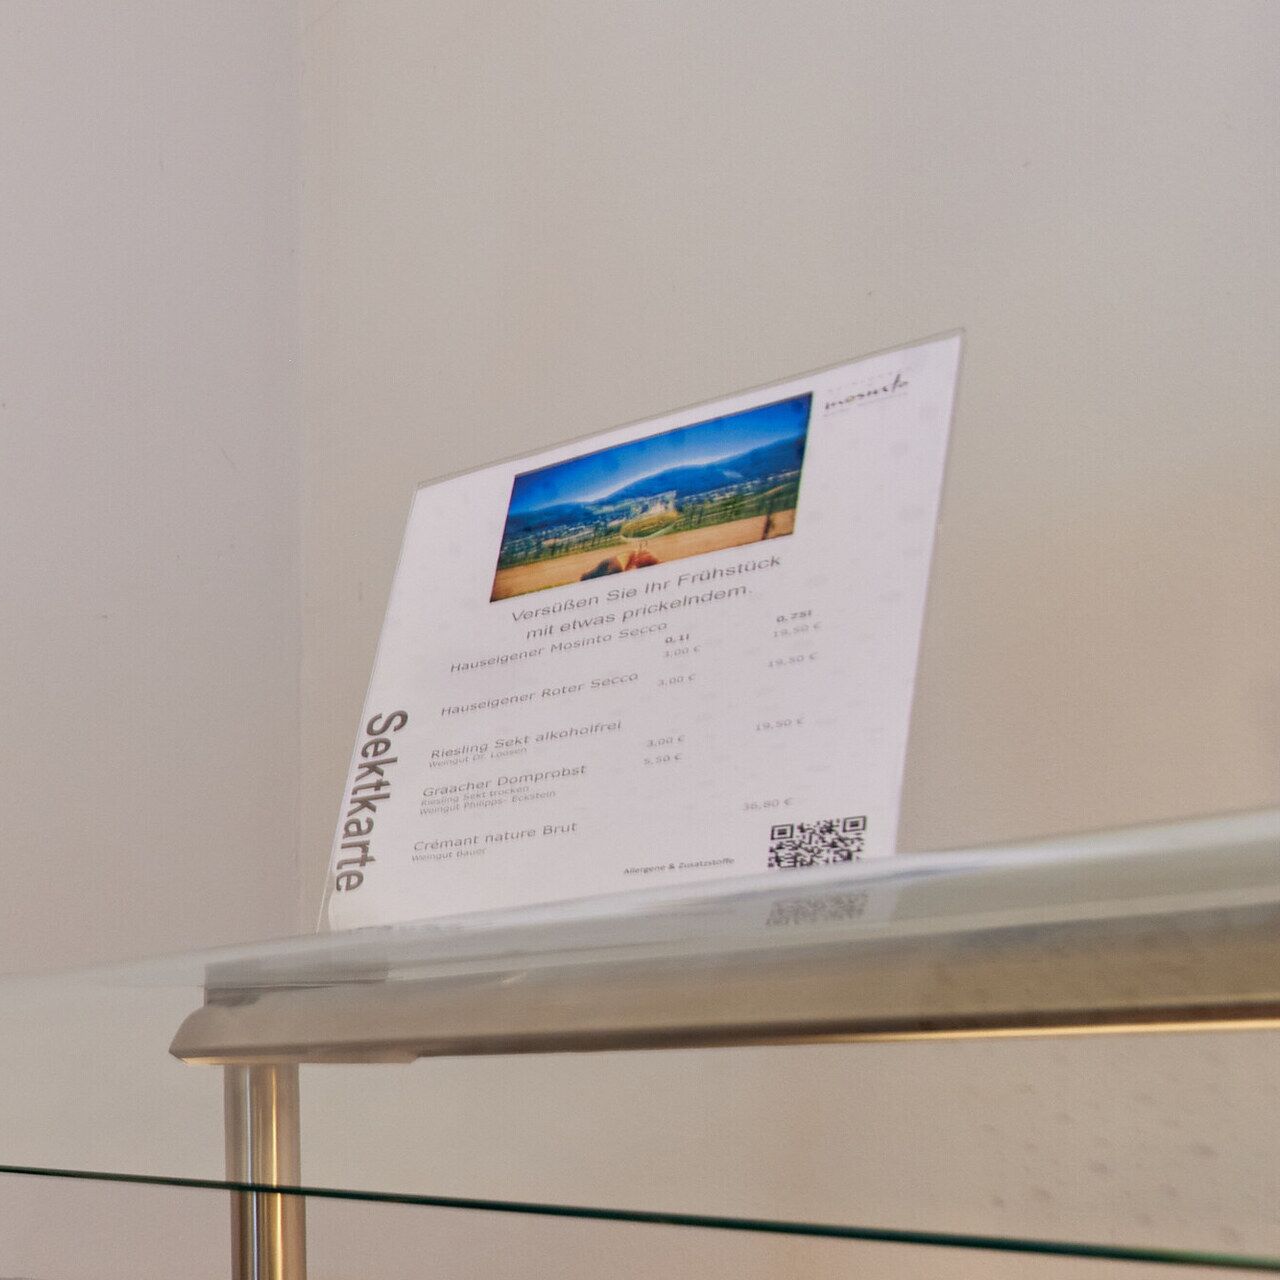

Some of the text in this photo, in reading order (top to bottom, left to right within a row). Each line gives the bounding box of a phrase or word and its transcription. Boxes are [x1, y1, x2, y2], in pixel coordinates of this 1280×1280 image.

[511, 556, 781, 623] Versüßen Sie Ihr Frühstück
[526, 583, 754, 640] mit etwas prickelndem.
[450, 621, 668, 673] Hauseigener Mosinto Secco
[440, 671, 640, 717] Hauseigener Roter Secco
[430, 719, 623, 760] Riesling Sekt alkoholfrei
[422, 764, 588, 799] Graacher Domprobst
[428, 755, 470, 769] Weingut
[335, 709, 409, 892] Sektkarte
[413, 821, 579, 852] Crémant nature Brut
[623, 864, 667, 876] Allergene
[678, 857, 736, 870] Zusatzstoffe
